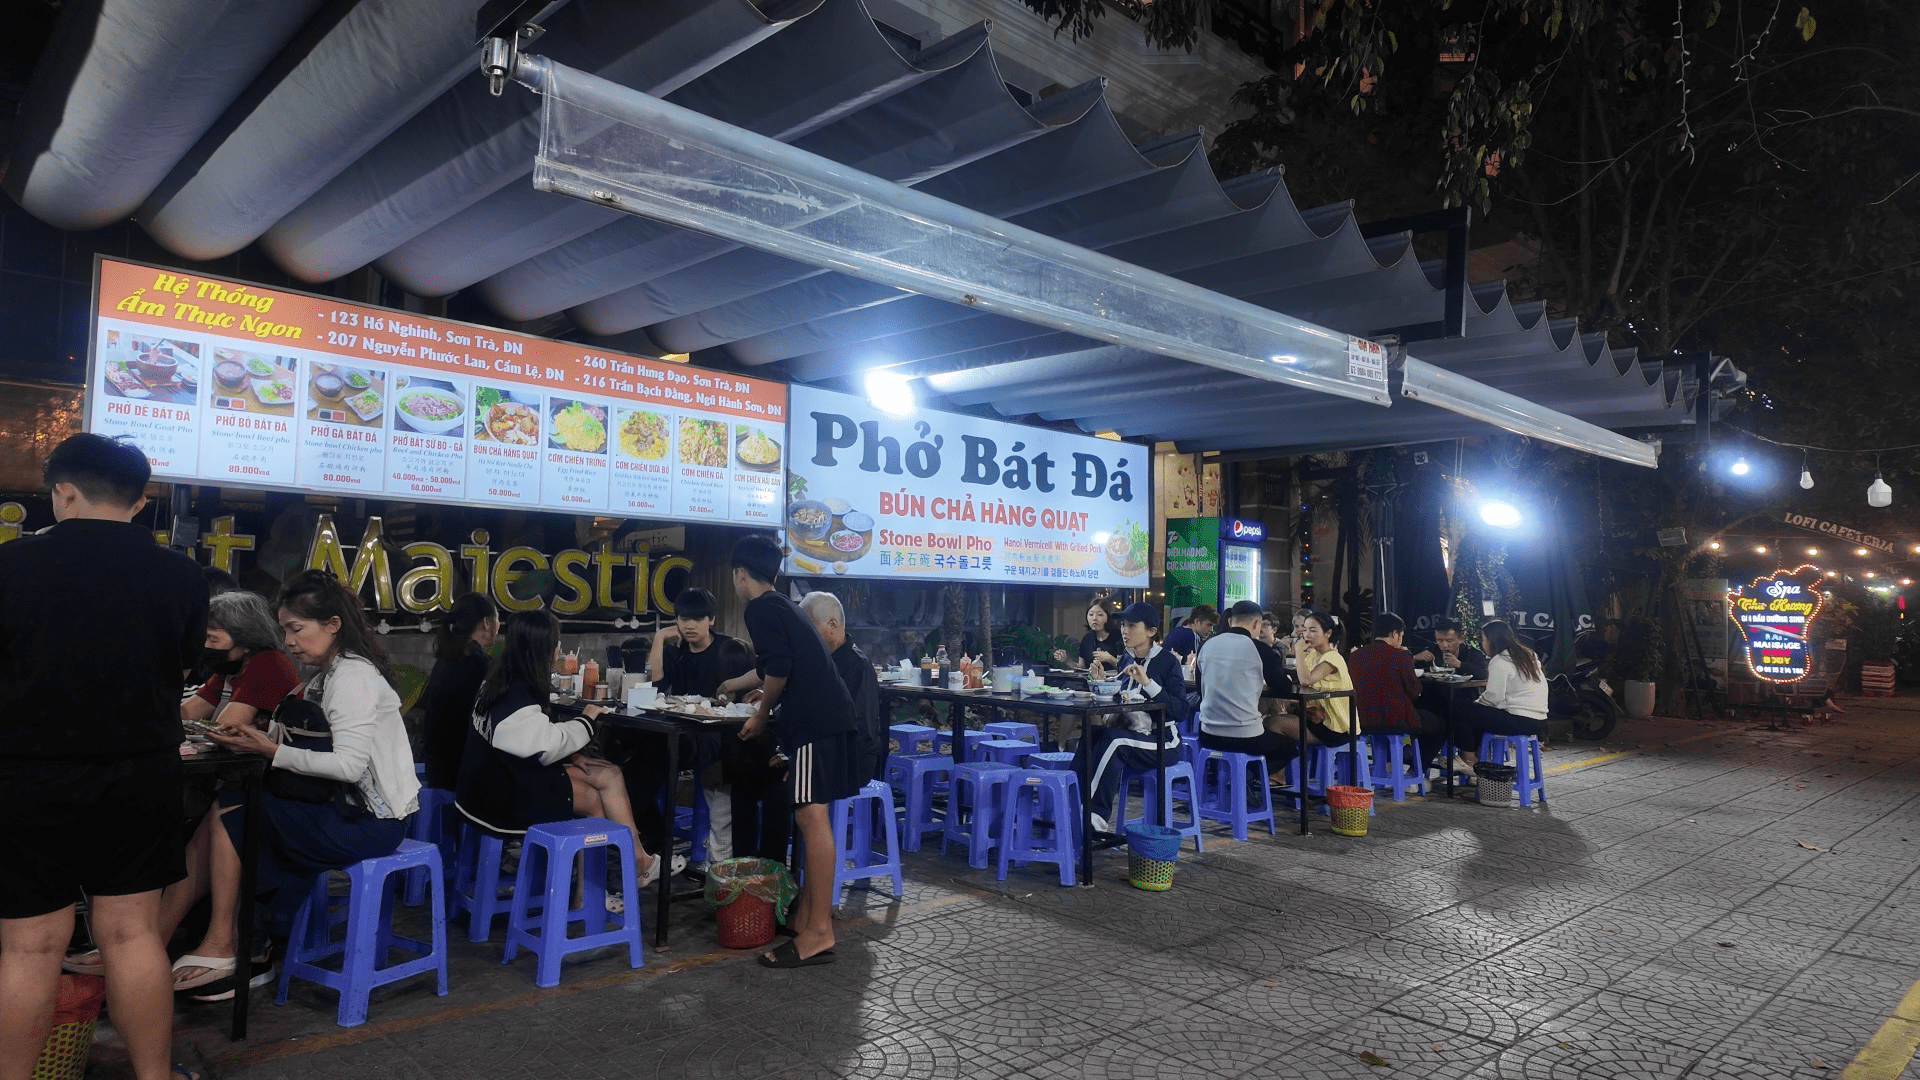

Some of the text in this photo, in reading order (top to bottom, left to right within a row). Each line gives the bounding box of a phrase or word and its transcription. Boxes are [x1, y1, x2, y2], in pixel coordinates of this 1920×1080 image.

[153, 273, 275, 313] Hệ Thống
[116, 288, 303, 339] Ẩm Thực Ngon
[330, 310, 523, 355] 123 Hồ Nghinh, Sơn Trà, ĐN
[327, 331, 358, 348] 207
[362, 336, 416, 358] Nguyễn
[419, 346, 461, 365] Phước
[464, 354, 491, 370] Lan,
[525, 365, 542, 379] Lệ,
[545, 367, 565, 381] ĐN
[583, 354, 750, 394] 260 Trần Hưng Đạo, Sơn Trà, ĐN
[583, 374, 782, 416] 216 Trần Bạch Đằng, Ngũ Hành Sơn, ĐN
[107, 401, 191, 422] PHỞ DÊ BÁT ĐÁ
[103, 417, 193, 433] Stone Bowl Goat Pho
[215, 413, 236, 426] PHỞ
[254, 418, 272, 430] BÁT
[274, 420, 287, 432] ĐÁ
[257, 434, 275, 442] Beef
[310, 424, 377, 443] PHỞ GÀ BÁT ĐÁ
[392, 434, 408, 446] PHỞ
[410, 436, 424, 448] BÁT
[342, 443, 369, 452] Chicken
[423, 450, 449, 458] Chicken
[473, 443, 487, 454] BÚN
[503, 447, 521, 458] HÀNG
[522, 450, 538, 462] QUẠT
[810, 411, 1134, 502] Phở Bát Đá
[548, 453, 563, 463] CƠM
[228, 465, 270, 476] 80.000vnd
[879, 487, 1089, 537] BÚN CHẢ HÀNG QUẠT
[879, 528, 992, 552] Stone Bowl Pho
[1243, 525, 1262, 537] pepsi
[1783, 512, 1894, 554] LOFI CAFETERIA
[1004, 537, 1102, 553] Hanoi Vermicelli With Grilled Pork
[303, 513, 694, 616] Majestic
[1766, 580, 1801, 598] Spa
[1789, 615, 1805, 623] SINH
